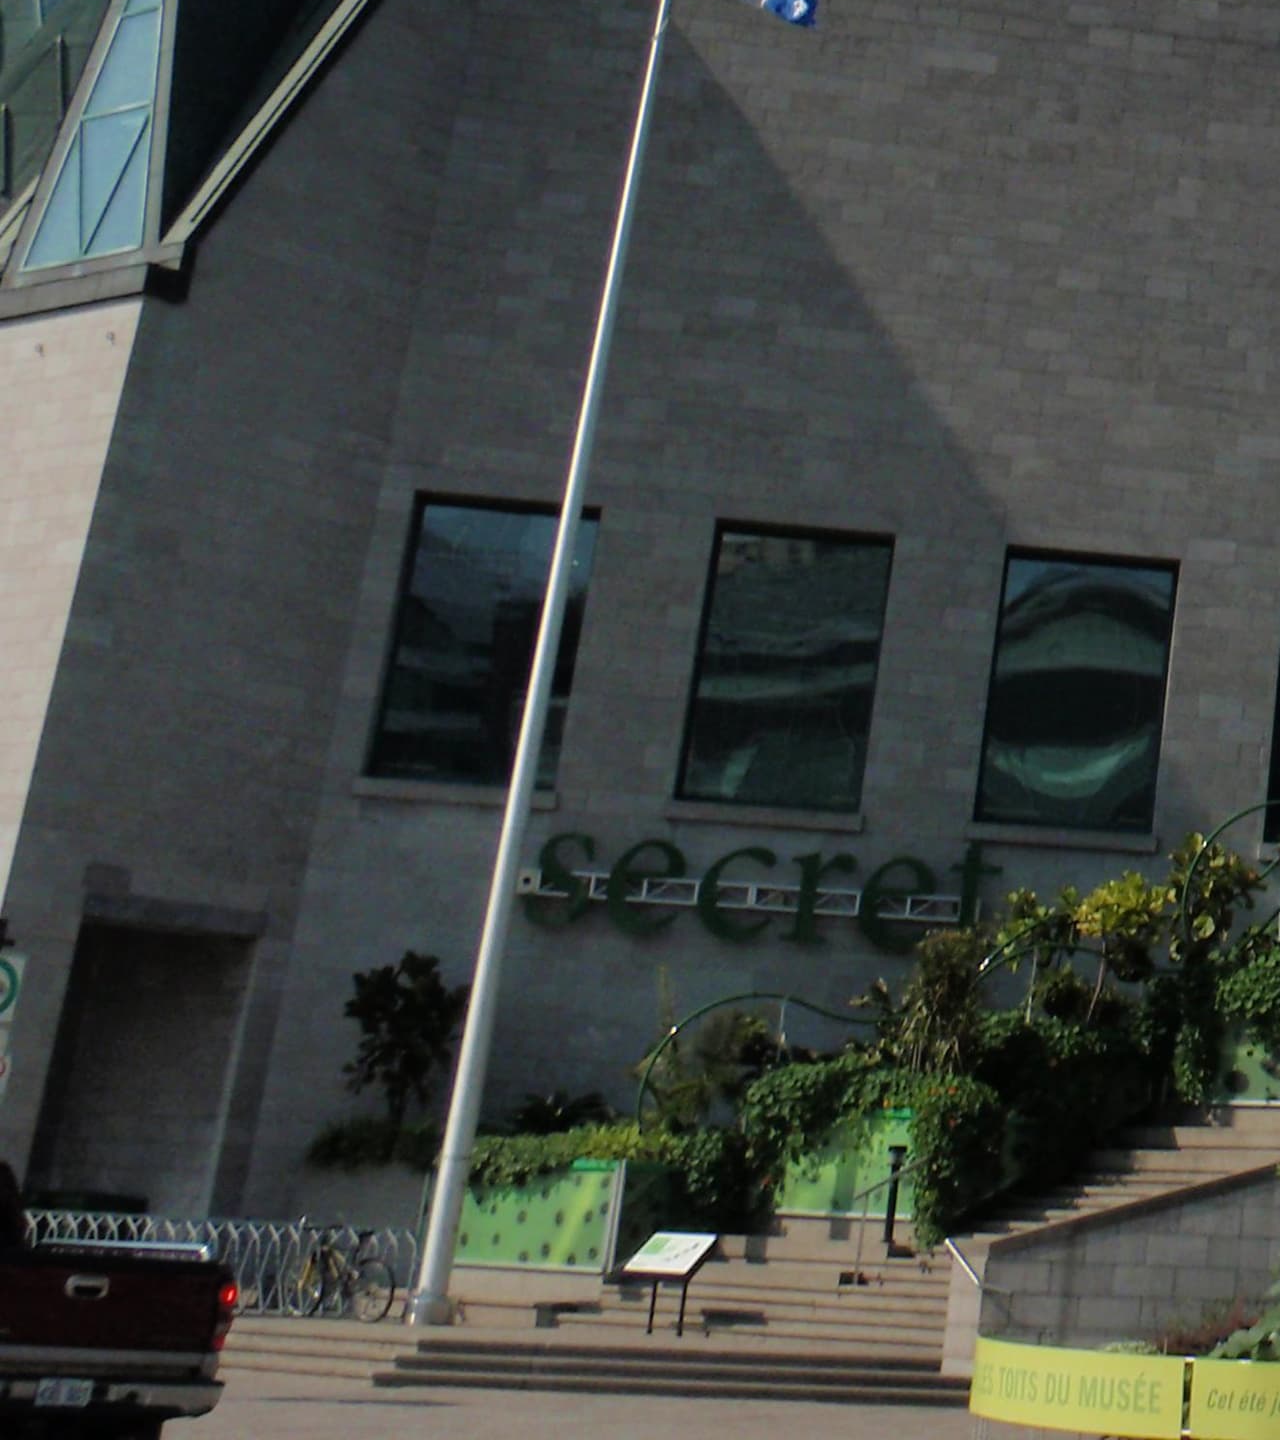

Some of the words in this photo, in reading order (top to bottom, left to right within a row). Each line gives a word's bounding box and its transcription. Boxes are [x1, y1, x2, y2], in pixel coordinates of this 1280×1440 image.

[523, 832, 1004, 956] secret
[998, 1366, 1038, 1403] TOITS
[1045, 1372, 1071, 1406] DU
[1078, 1373, 1162, 1413] MUSÉE
[1207, 1388, 1233, 1410] Cet
[1239, 1391, 1267, 1411] été
